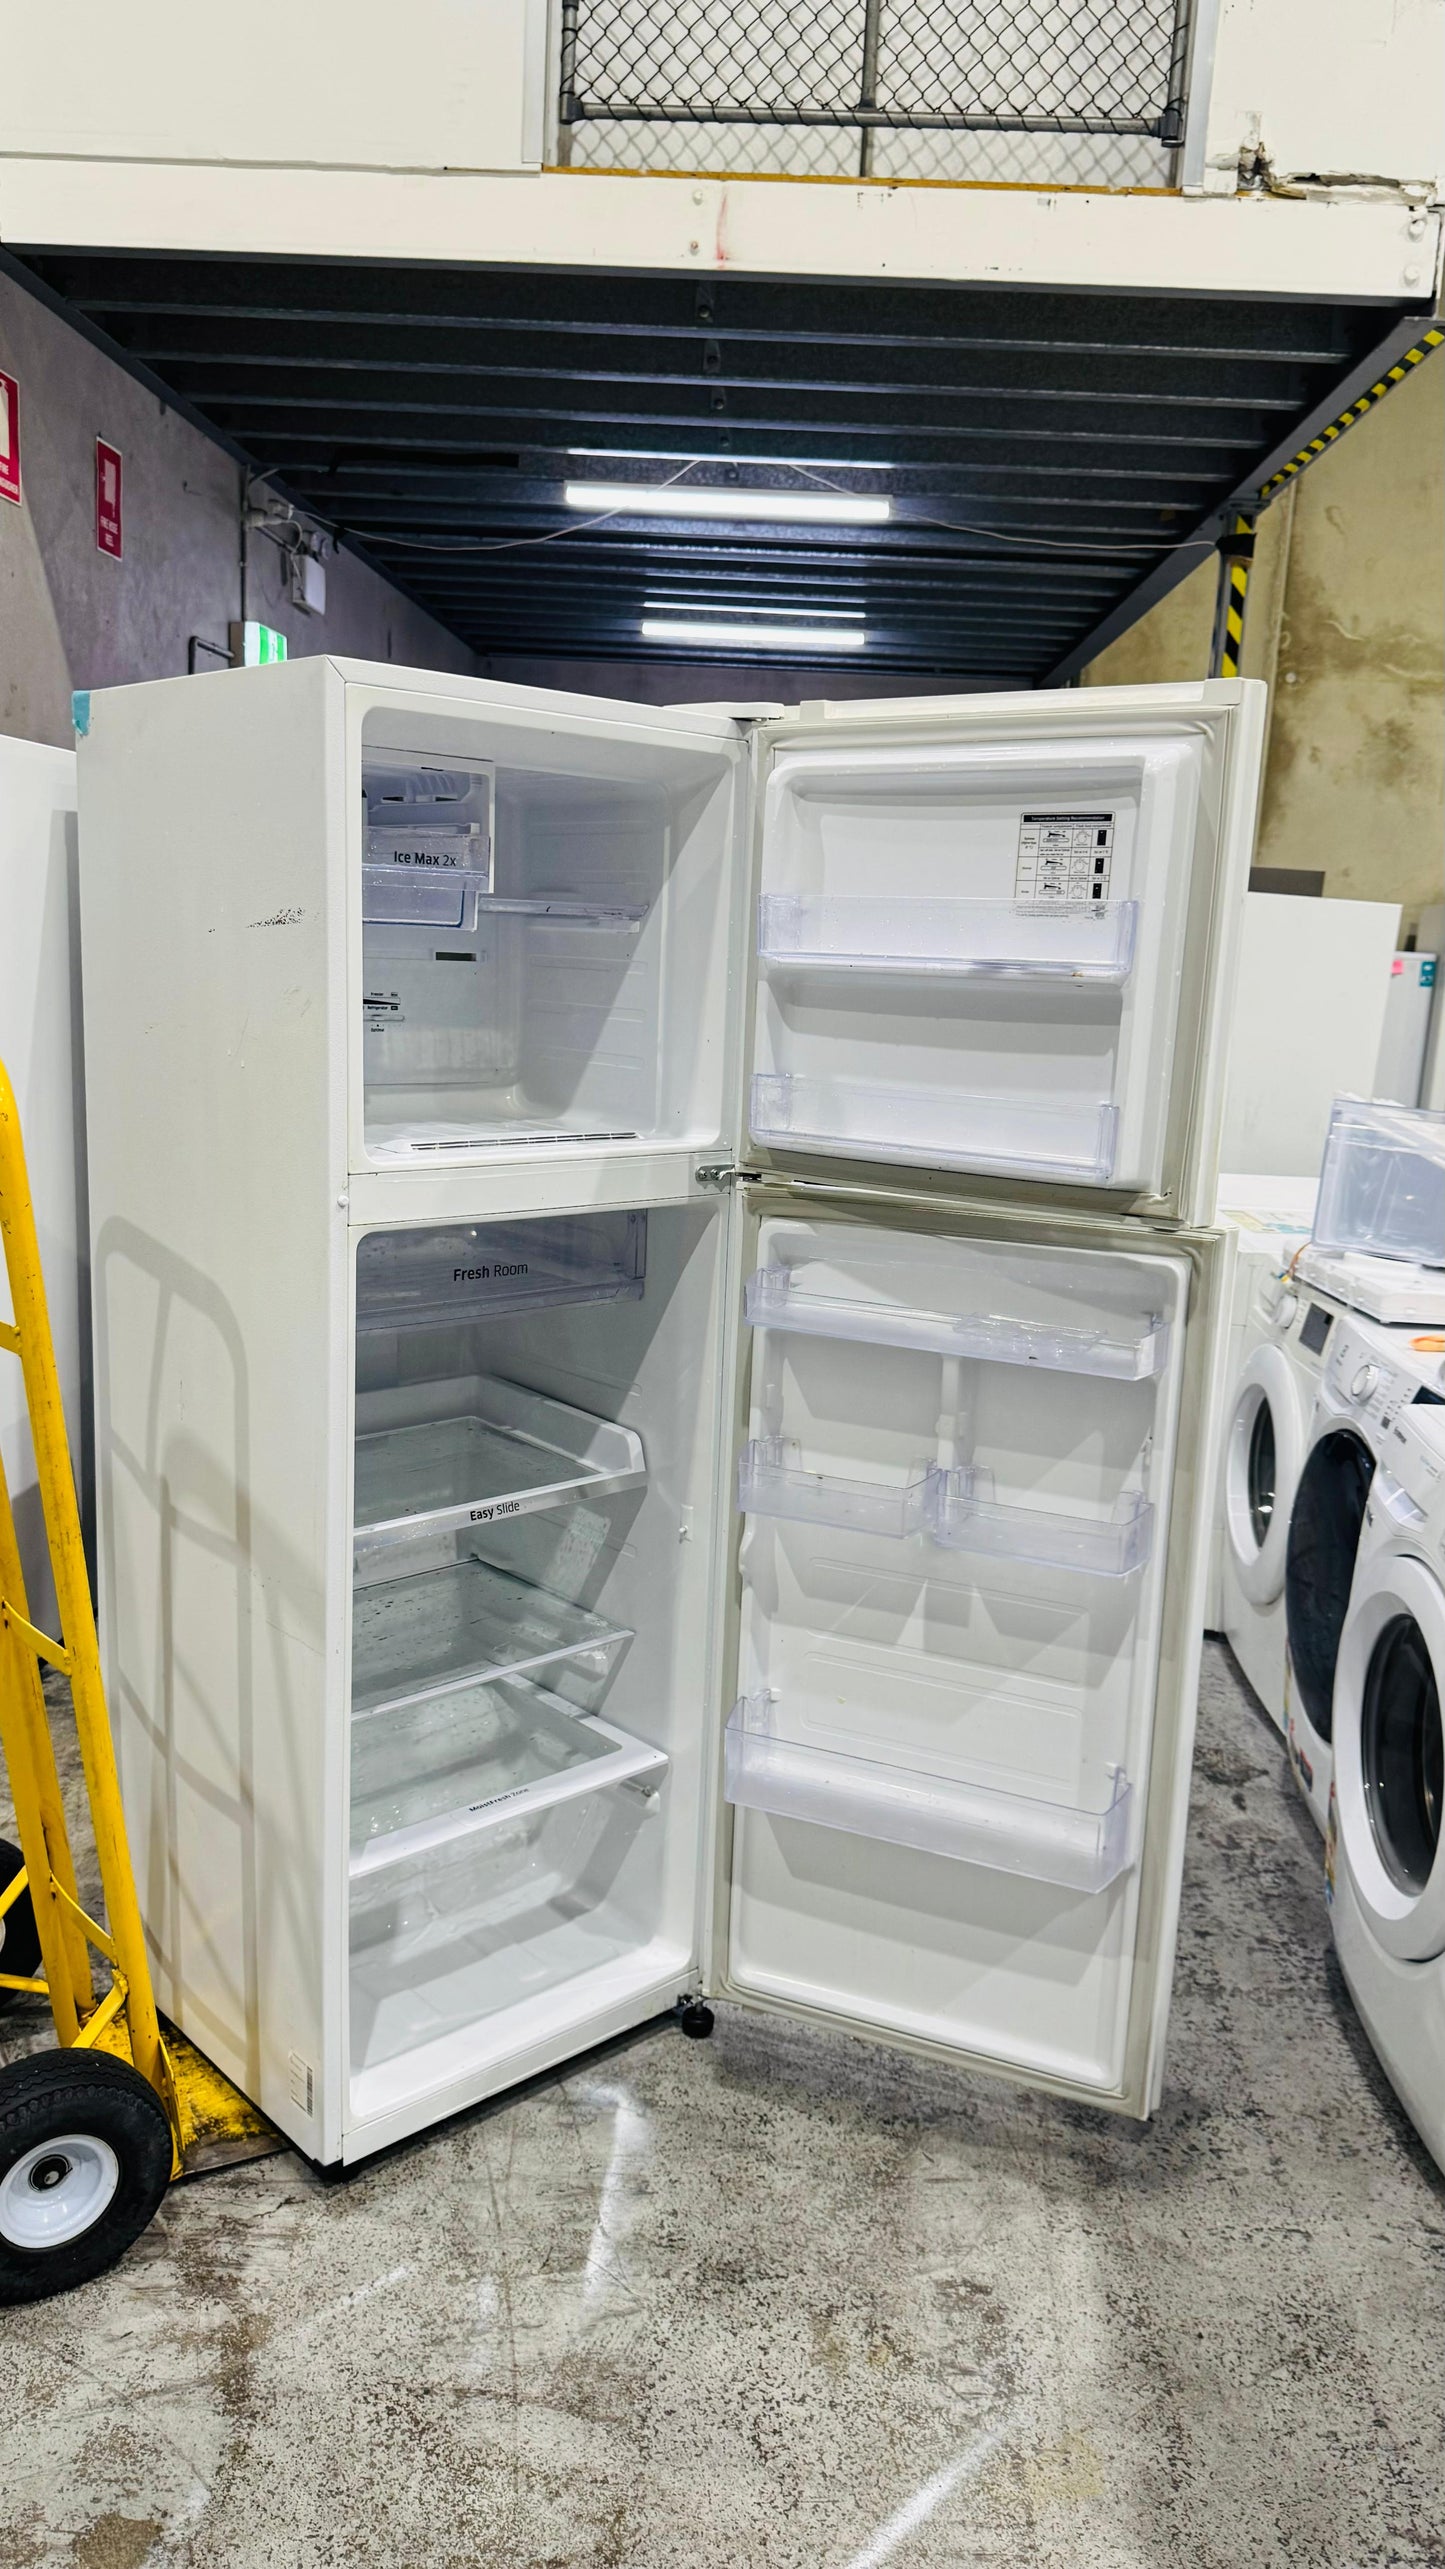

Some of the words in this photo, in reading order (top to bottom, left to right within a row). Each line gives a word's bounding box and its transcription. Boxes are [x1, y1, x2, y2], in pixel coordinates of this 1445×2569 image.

[394, 851, 411, 863] Ice
[415, 853, 439, 865] Max
[443, 854, 456, 866] 2x
[454, 1265, 490, 1281] Fresh
[494, 1264, 528, 1277] Room
[470, 1508, 494, 1521] Easy
[496, 1501, 520, 1515] Slide
